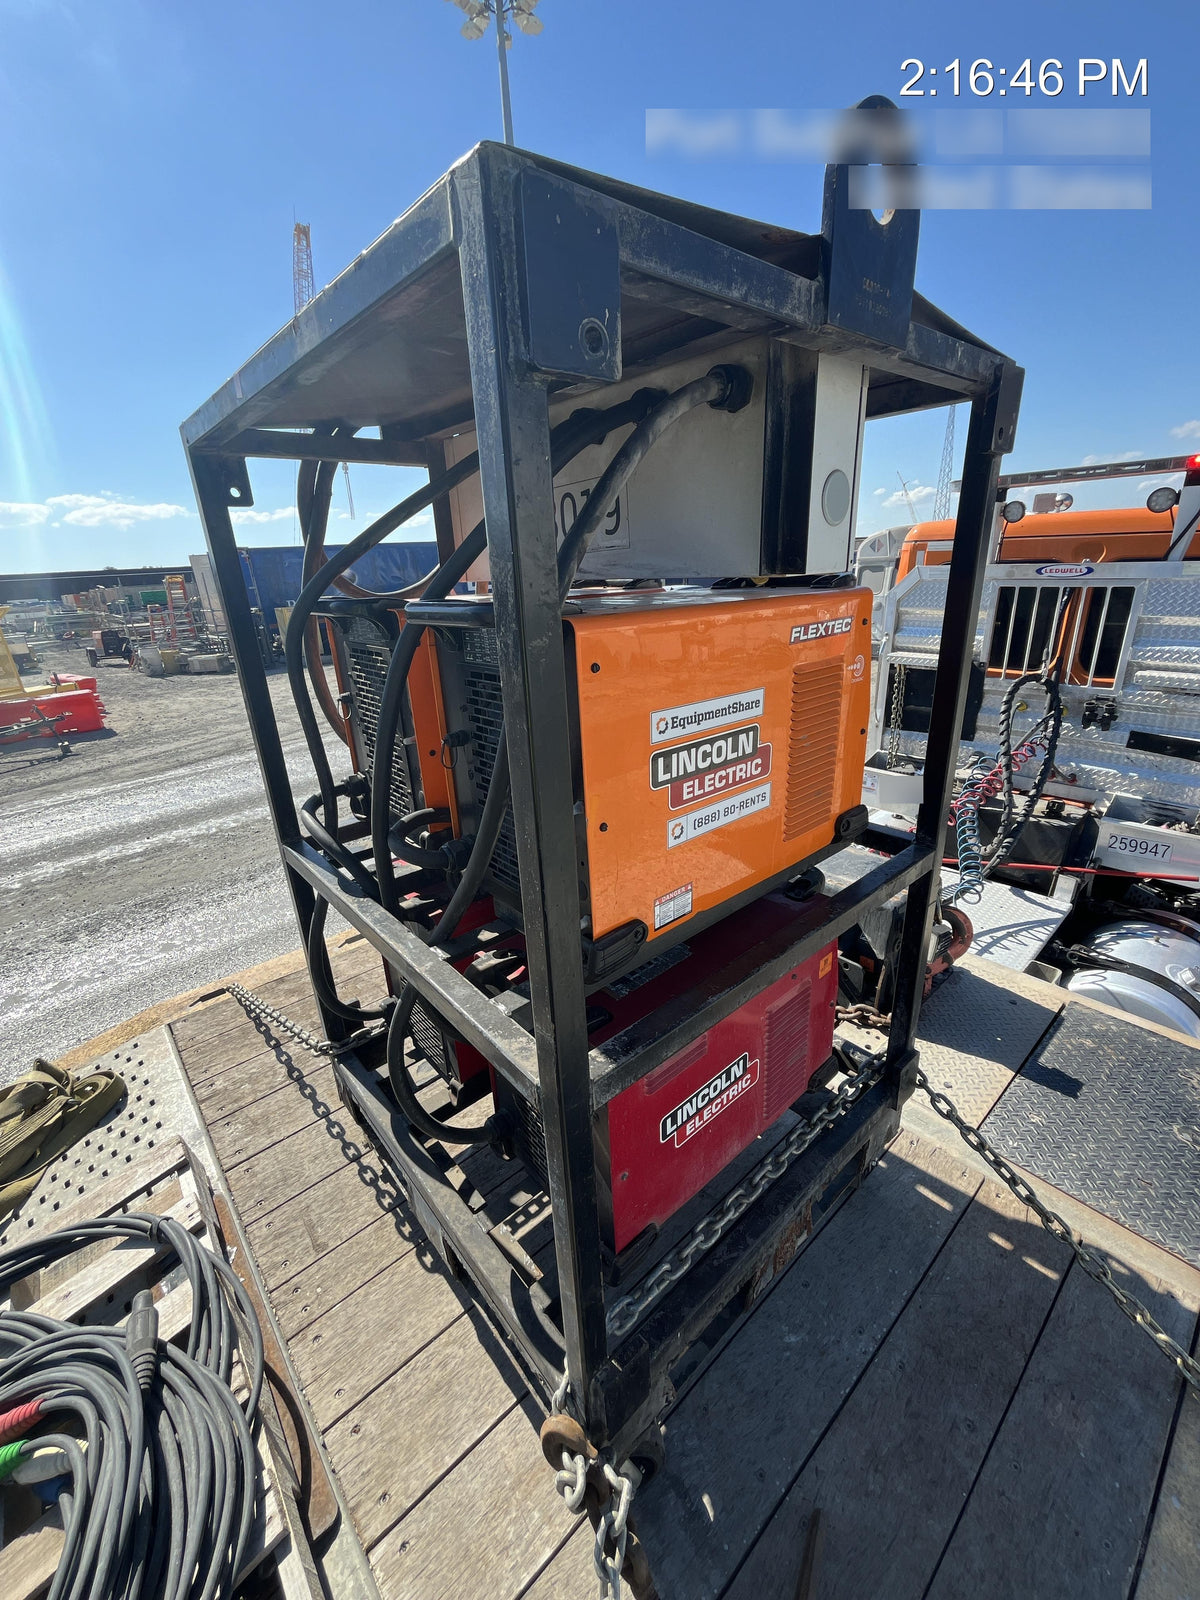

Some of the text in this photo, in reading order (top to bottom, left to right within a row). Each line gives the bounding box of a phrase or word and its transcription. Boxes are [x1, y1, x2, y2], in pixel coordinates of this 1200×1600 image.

[790, 618, 852, 643] FLEXTEC
[670, 699, 761, 729] EquipmentShare
[657, 730, 754, 783] LINCOLN
[682, 757, 762, 801] ELECTRIC
[693, 792, 767, 831] (888) 80-RENTS
[1108, 835, 1171, 858] 259947
[661, 886, 686, 901] DANGER
[666, 1059, 744, 1136] LINCOLN
[686, 1073, 752, 1136] ELECTRIC
